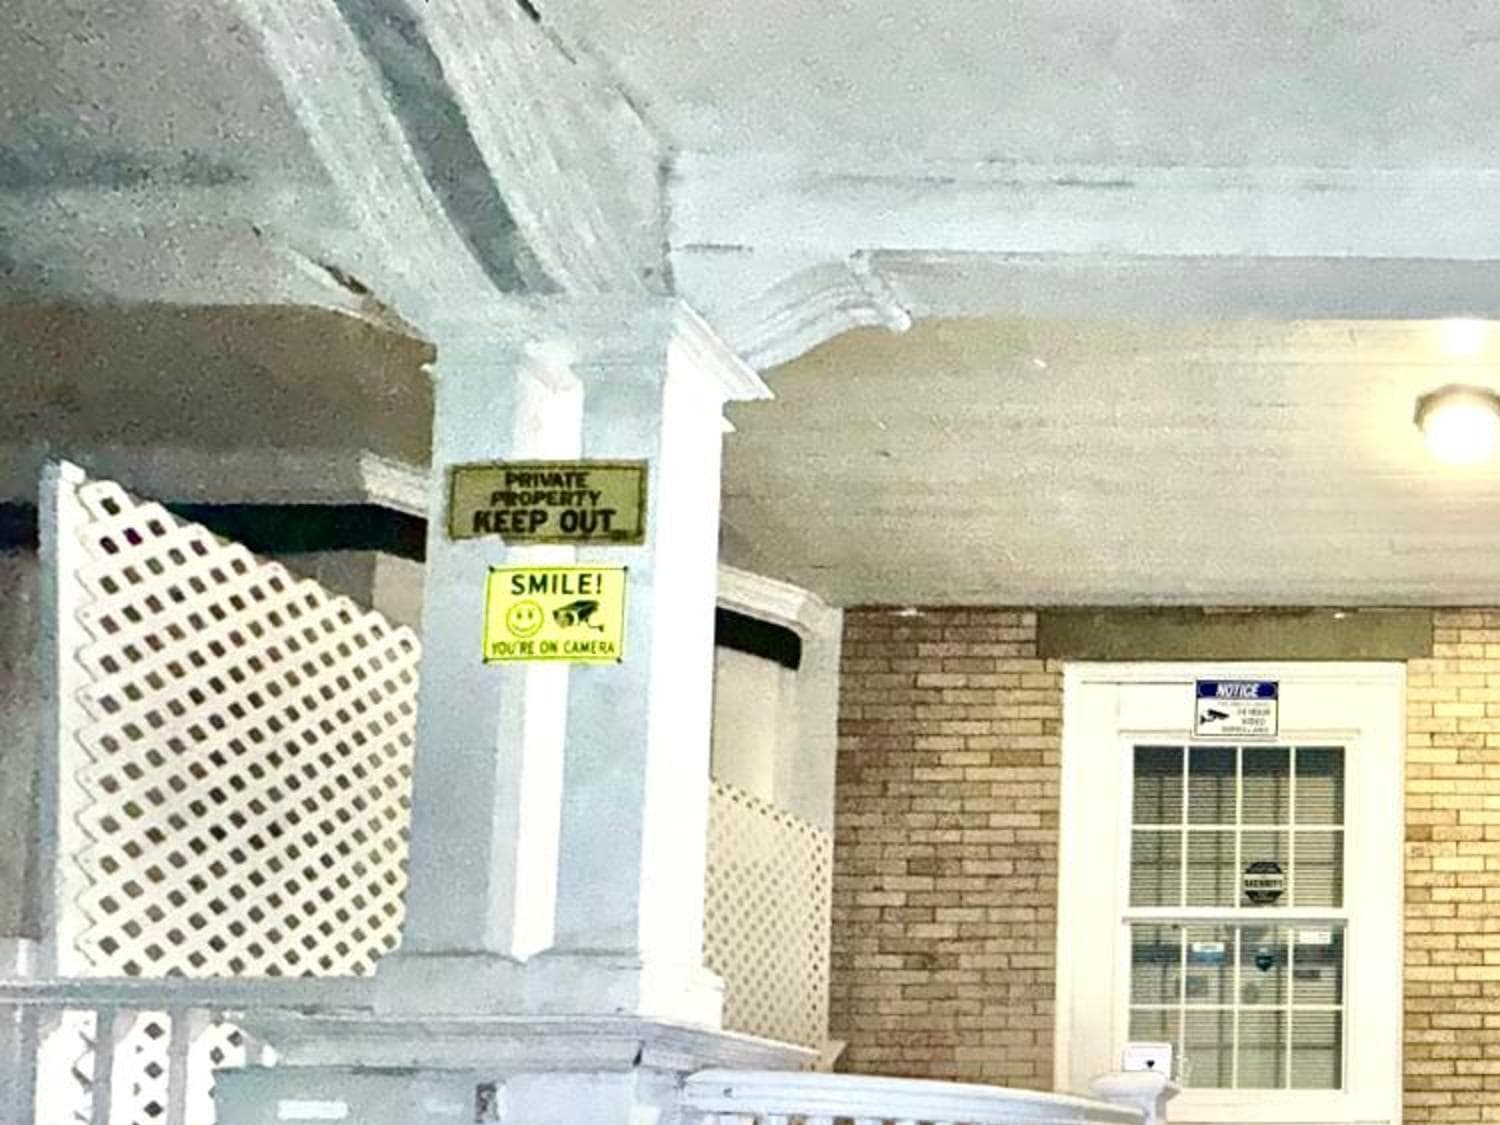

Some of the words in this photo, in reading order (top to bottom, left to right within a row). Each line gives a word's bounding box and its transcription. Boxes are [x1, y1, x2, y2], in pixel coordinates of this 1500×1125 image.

[505, 471, 590, 489] PRIVATE
[490, 489, 602, 507] PROPERTY
[473, 508, 548, 534] KEEP
[560, 508, 617, 534] OUT
[511, 573, 602, 595] SMILE!
[492, 640, 534, 655] YOU'RE
[540, 640, 558, 655] ON
[564, 639, 615, 655] CAMERA
[1216, 682, 1259, 697] NOTICE
